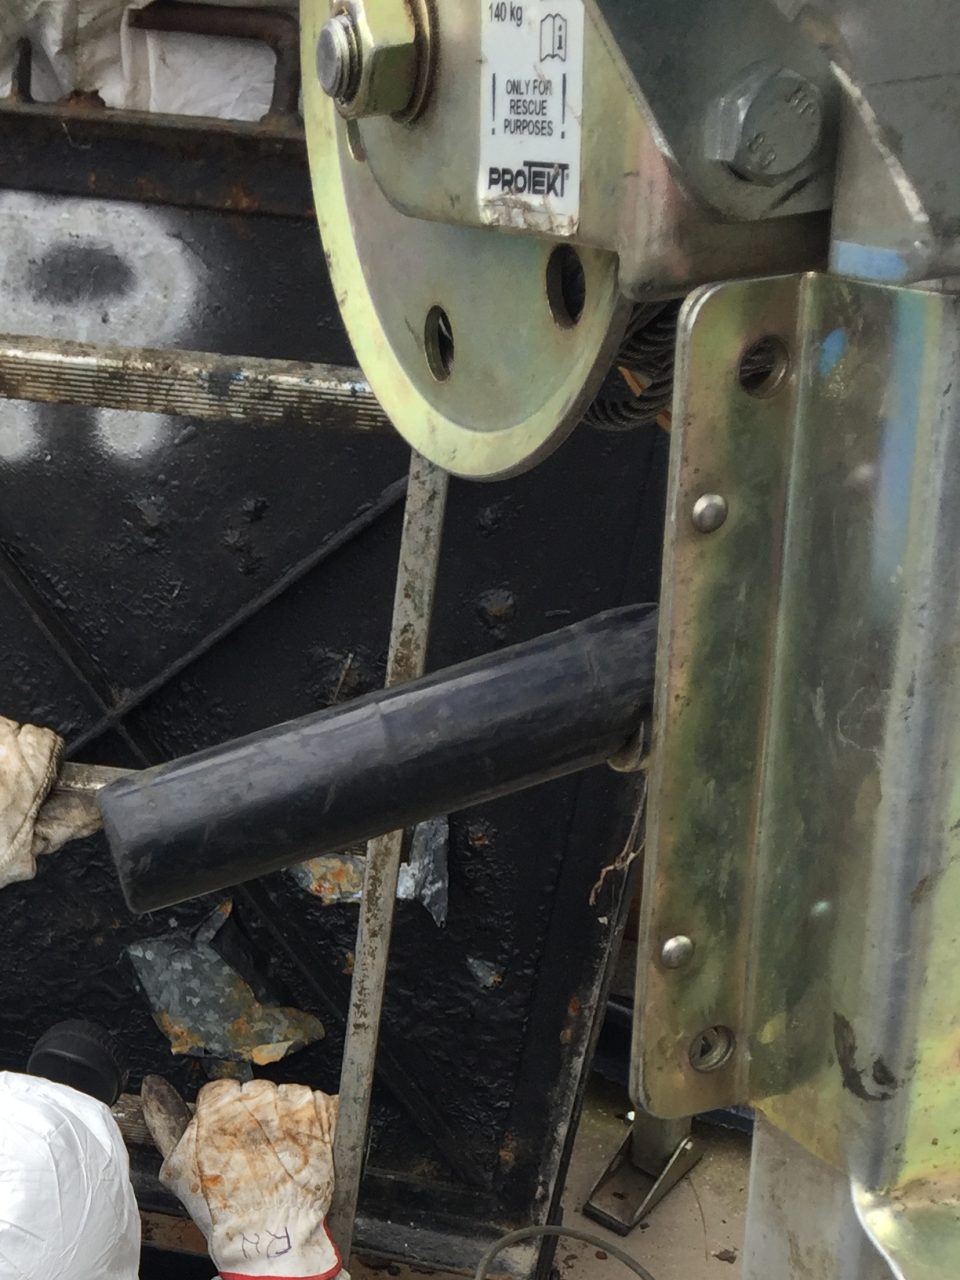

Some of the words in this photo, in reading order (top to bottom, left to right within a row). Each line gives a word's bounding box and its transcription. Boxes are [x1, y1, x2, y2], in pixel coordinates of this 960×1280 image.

[488, 2, 507, 22] 140
[510, 3, 523, 27] kg
[506, 79, 531, 96] ONLY
[533, 79, 553, 96] FOR
[509, 99, 548, 116] RESCUE
[503, 118, 554, 137] PURPOSES
